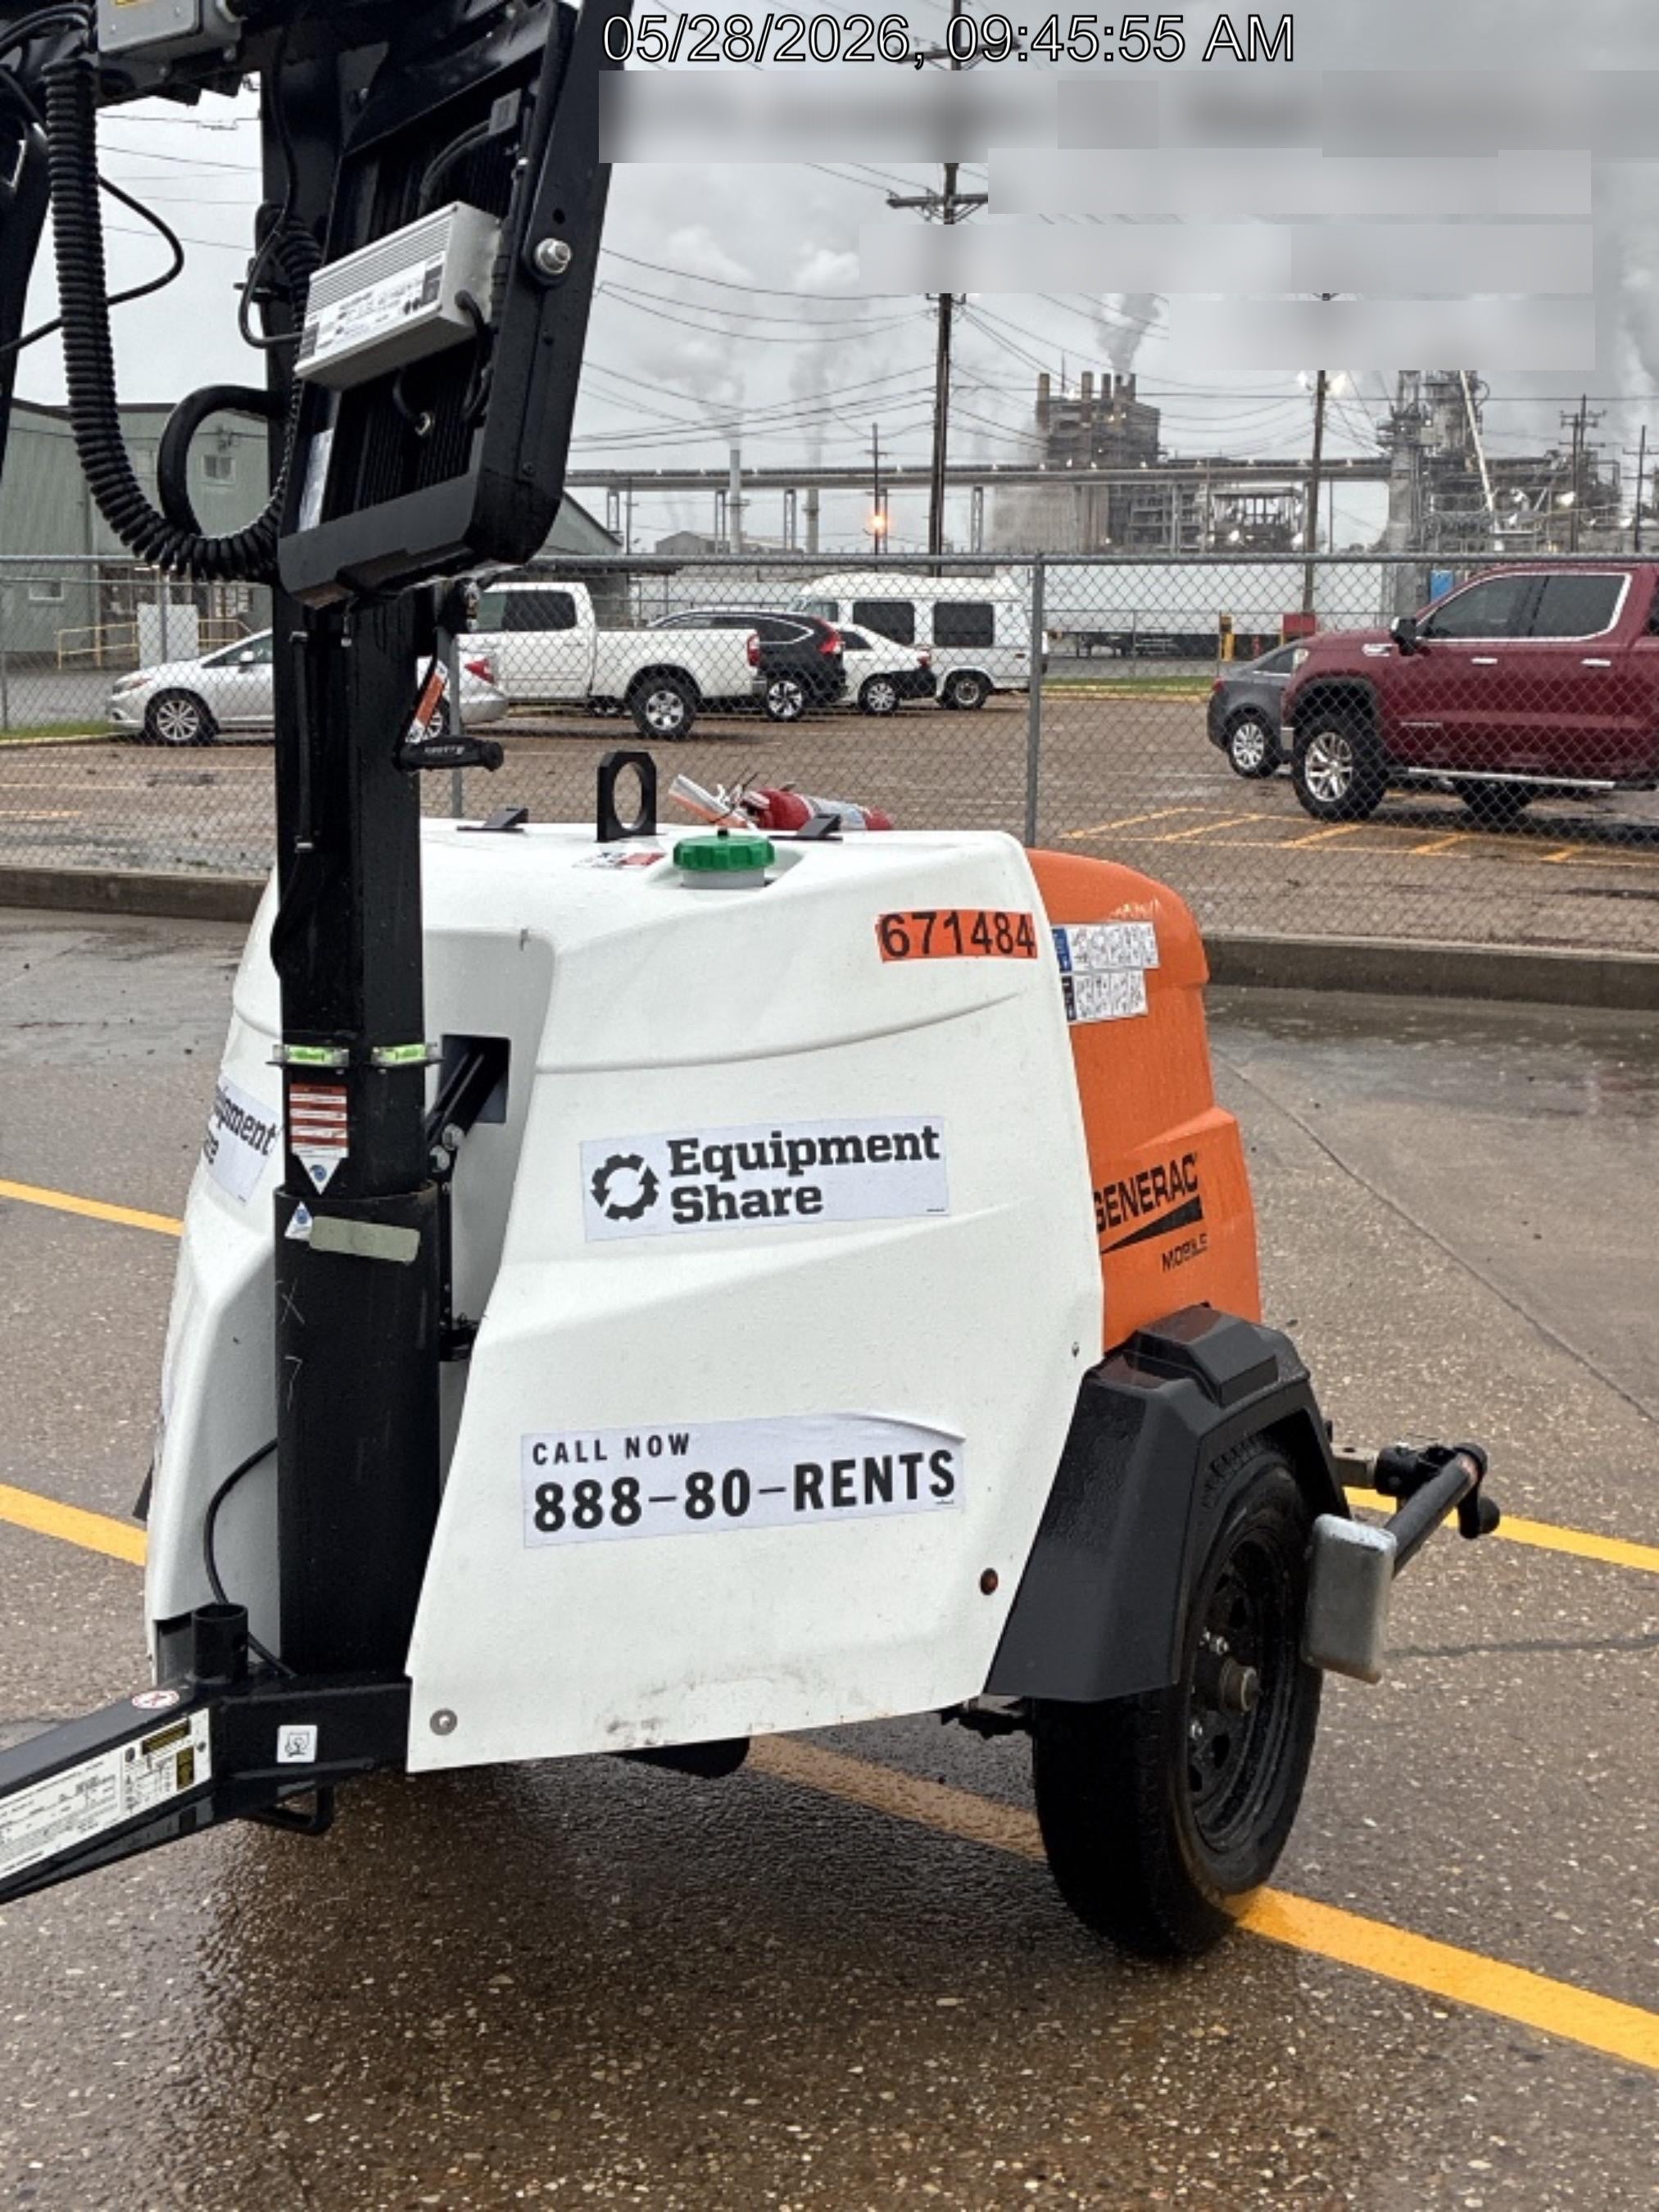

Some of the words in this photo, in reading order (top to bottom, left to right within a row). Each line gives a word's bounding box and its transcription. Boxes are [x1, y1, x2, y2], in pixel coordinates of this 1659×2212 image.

[880, 910, 1036, 958] 671484
[667, 1126, 941, 1182] Equipment
[670, 1184, 823, 1225] Share
[1094, 1153, 1199, 1233] GENERAC
[1162, 1232, 1208, 1273] MOBILE
[533, 1439, 608, 1466] CALL
[625, 1432, 690, 1459] NOW
